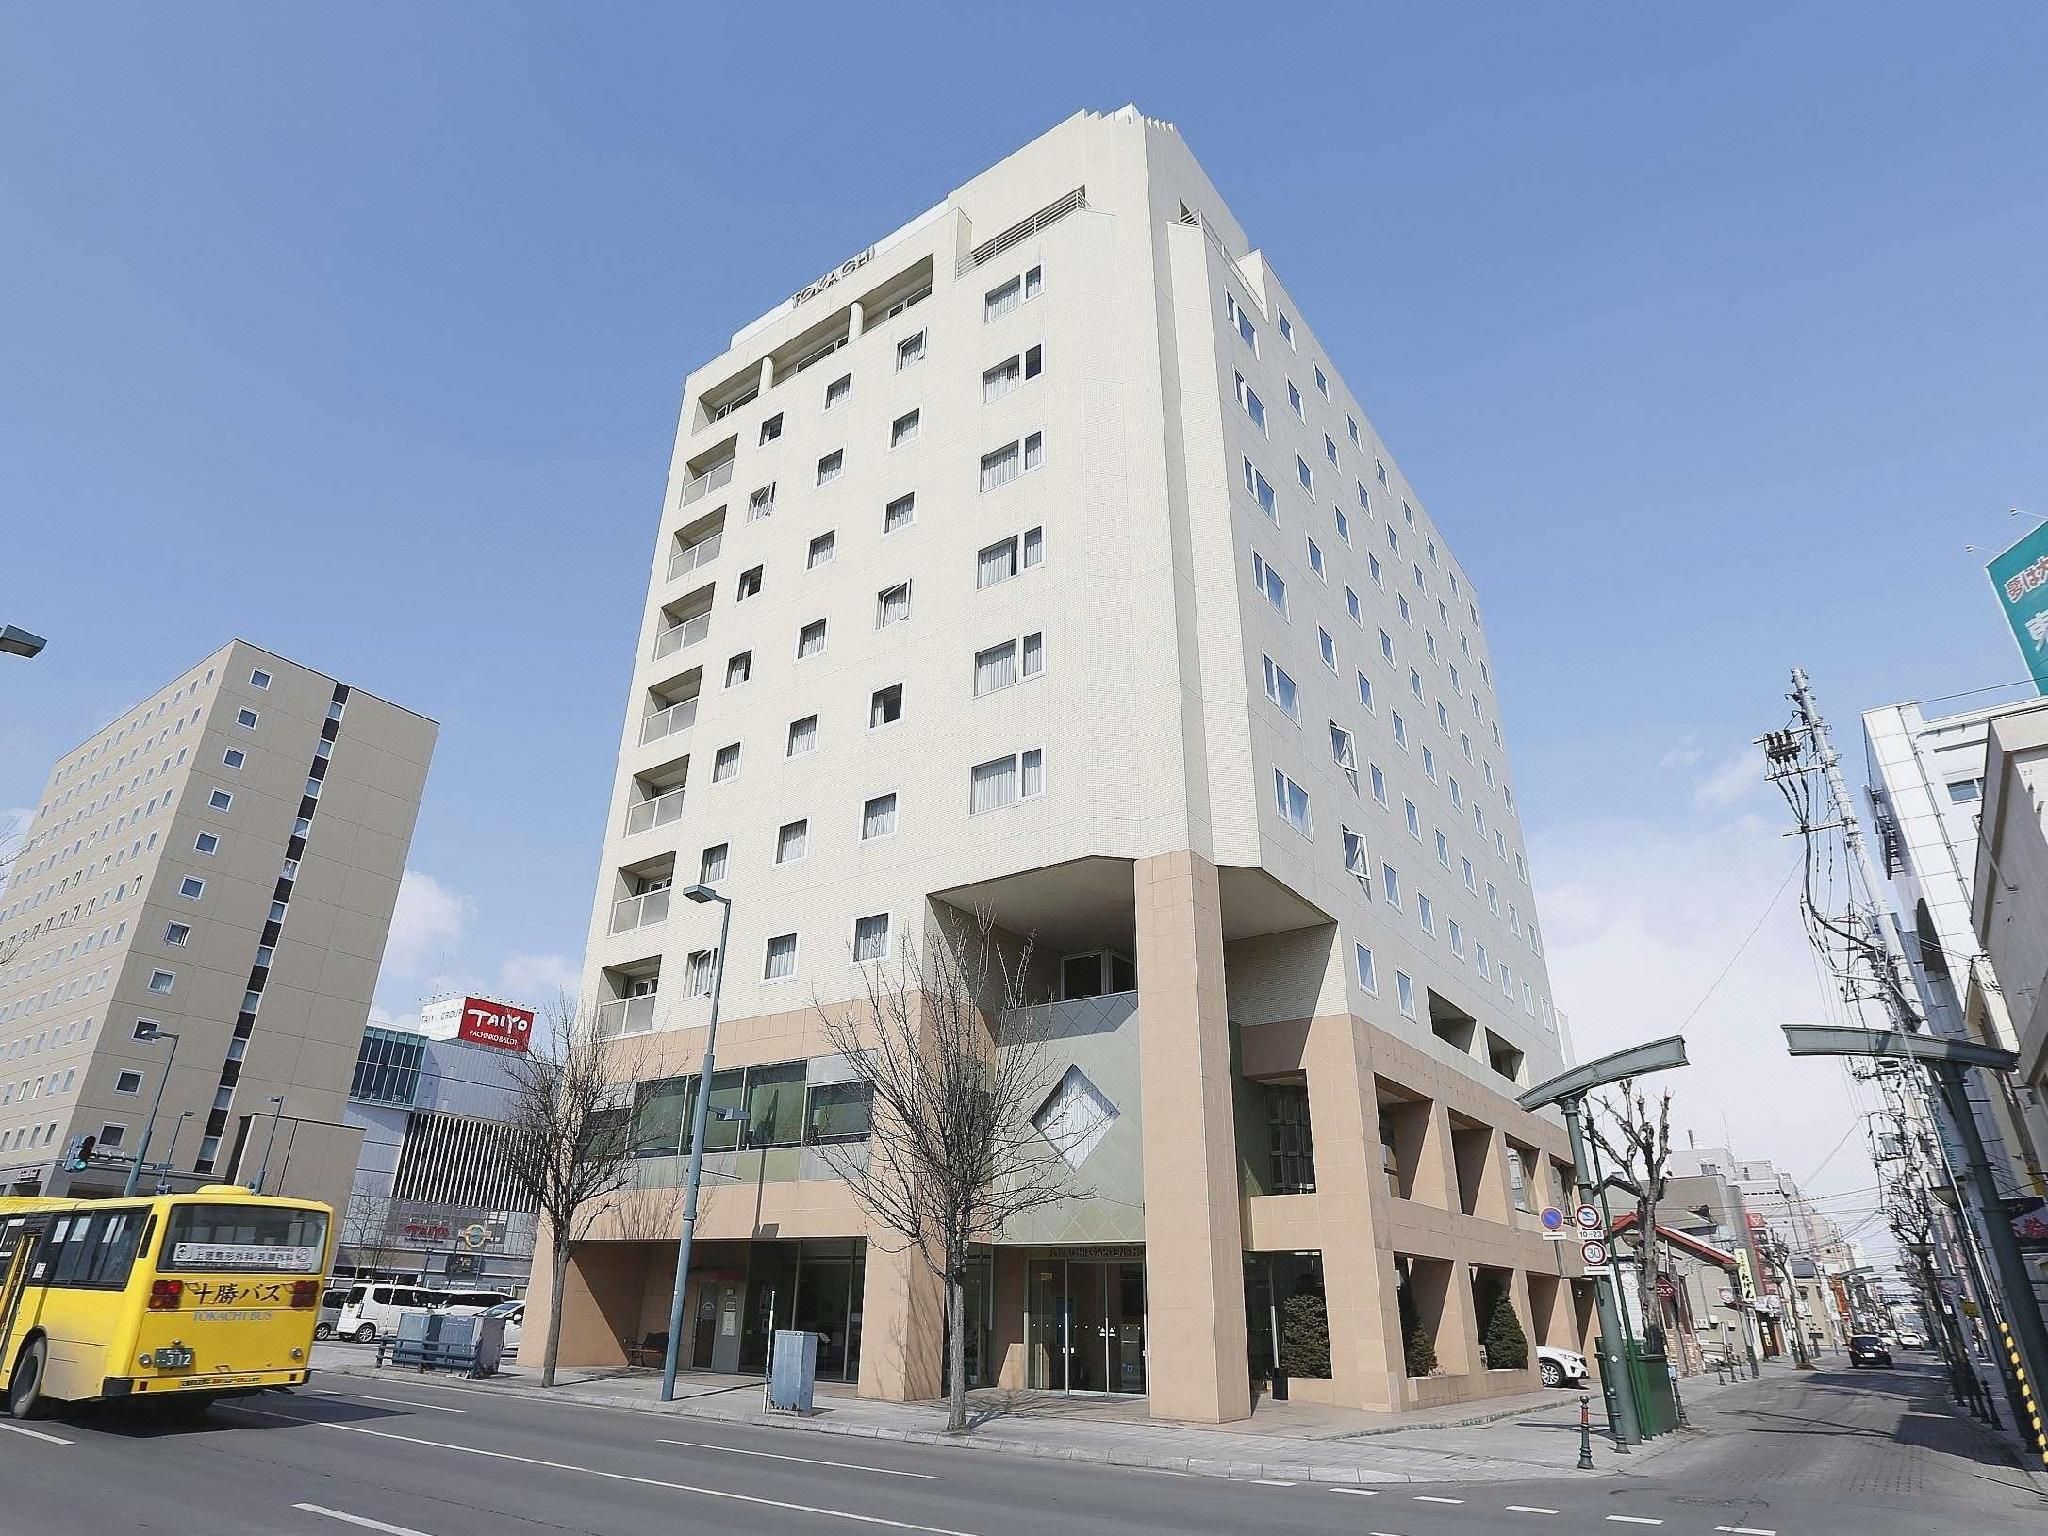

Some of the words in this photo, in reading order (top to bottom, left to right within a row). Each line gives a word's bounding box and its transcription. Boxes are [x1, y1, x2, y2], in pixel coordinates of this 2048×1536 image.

[467, 1008, 528, 1034] TAIYO
[1587, 1247, 1601, 1259] 30
[194, 1282, 280, 1305] 十勝バス
[193, 1310, 248, 1321] TOKACHI
[249, 1310, 273, 1321] BUS
